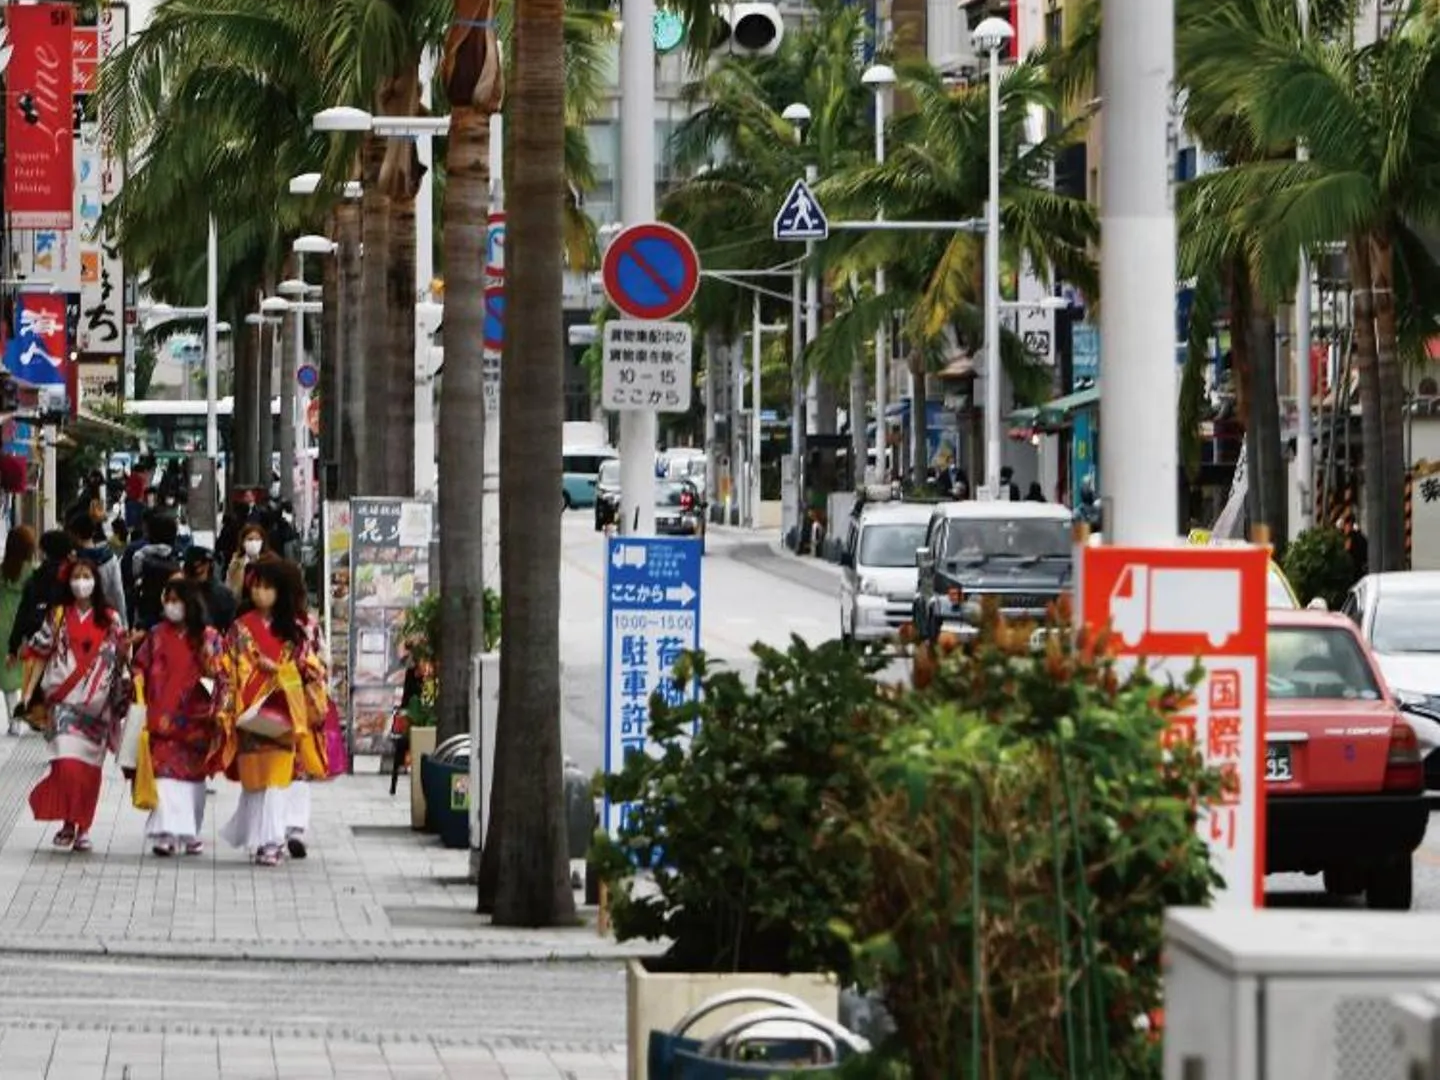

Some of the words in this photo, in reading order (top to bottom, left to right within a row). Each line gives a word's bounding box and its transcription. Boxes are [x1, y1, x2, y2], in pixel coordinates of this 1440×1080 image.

[20, 307, 65, 367] 海人
[612, 388, 680, 406] ここから
[612, 583, 664, 604] ここから
